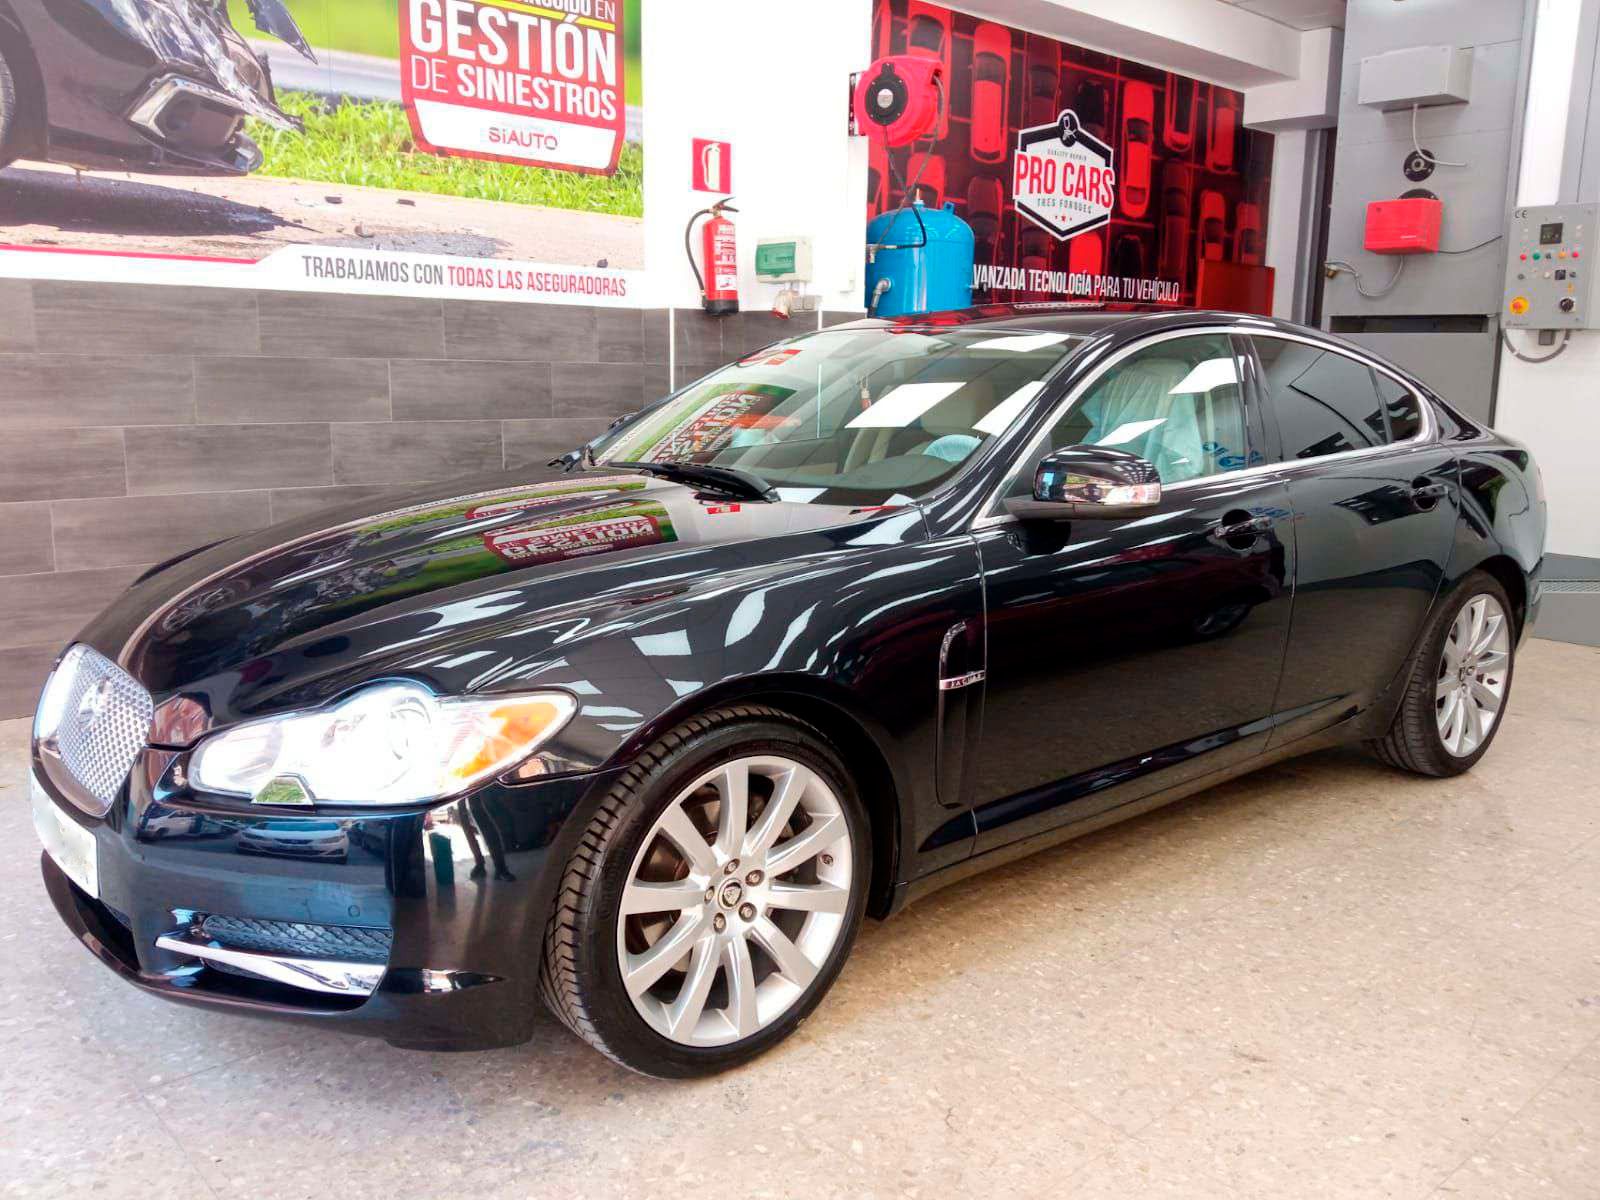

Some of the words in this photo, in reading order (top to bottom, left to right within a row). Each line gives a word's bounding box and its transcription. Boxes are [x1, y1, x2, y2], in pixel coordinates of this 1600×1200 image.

[595, 0, 616, 22] EN
[409, 0, 616, 87] GESTIÓN
[411, 54, 449, 94] DE
[457, 63, 617, 121] SINIESTROS
[1015, 153, 1057, 196] PRO
[1062, 161, 1115, 208] CARS
[302, 255, 409, 283] TRABAJAMOS
[413, 264, 444, 286] CON
[448, 265, 494, 289] TODAS
[498, 269, 523, 291] LAS
[527, 271, 627, 297] ASEGURADORAS
[973, 263, 1026, 291] VANZADA
[1027, 268, 1092, 296] TECNOLOGÍA
[1094, 275, 1120, 298] PARA
[1122, 277, 1136, 299] TU
[1136, 276, 1180, 302] VEHÍCULO
